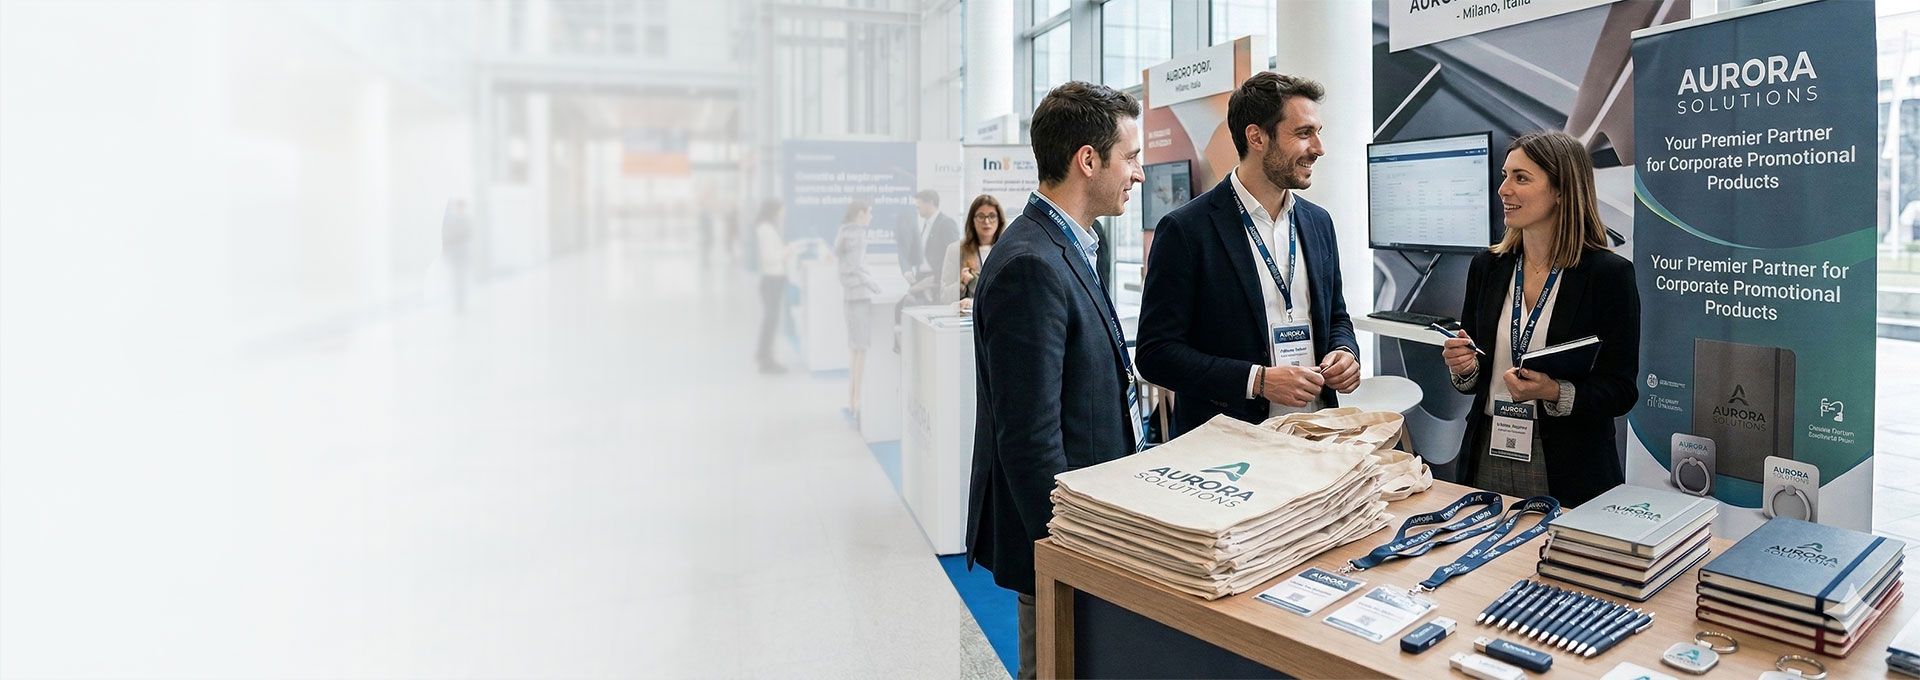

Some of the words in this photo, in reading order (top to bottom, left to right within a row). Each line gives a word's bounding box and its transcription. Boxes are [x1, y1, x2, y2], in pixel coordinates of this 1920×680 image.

[1463, 3, 1500, 19] Milano,
[1677, 51, 1818, 95] AURORA
[1677, 86, 1818, 115] SOLUTIONS
[1665, 136, 1697, 151] Your
[1701, 131, 1762, 149] Premier
[1768, 127, 1833, 144] Partner
[1647, 157, 1666, 172] for
[1669, 154, 1743, 173] Corporate
[1748, 145, 1856, 168] Promotional
[1707, 174, 1779, 190] Products
[1651, 254, 1683, 271] Your
[1687, 256, 1748, 274] Premier
[1752, 259, 1817, 277] Partner
[1822, 261, 1849, 279] for
[1656, 276, 1729, 295] Corporate
[1733, 280, 1841, 303] Promotional
[1705, 300, 1778, 321] Products
[1500, 405, 1528, 414] AURORA
[1712, 406, 1766, 422] AURORA
[1712, 416, 1767, 433] SOLUTIONS
[1678, 441, 1708, 451] AURORA
[1773, 466, 1809, 479] AURORA
[1134, 472, 1241, 508] SOLUTIONS
[1148, 467, 1254, 502] AURORA
[1606, 504, 1661, 520] AURORA
[1769, 545, 1838, 564] AURORA
